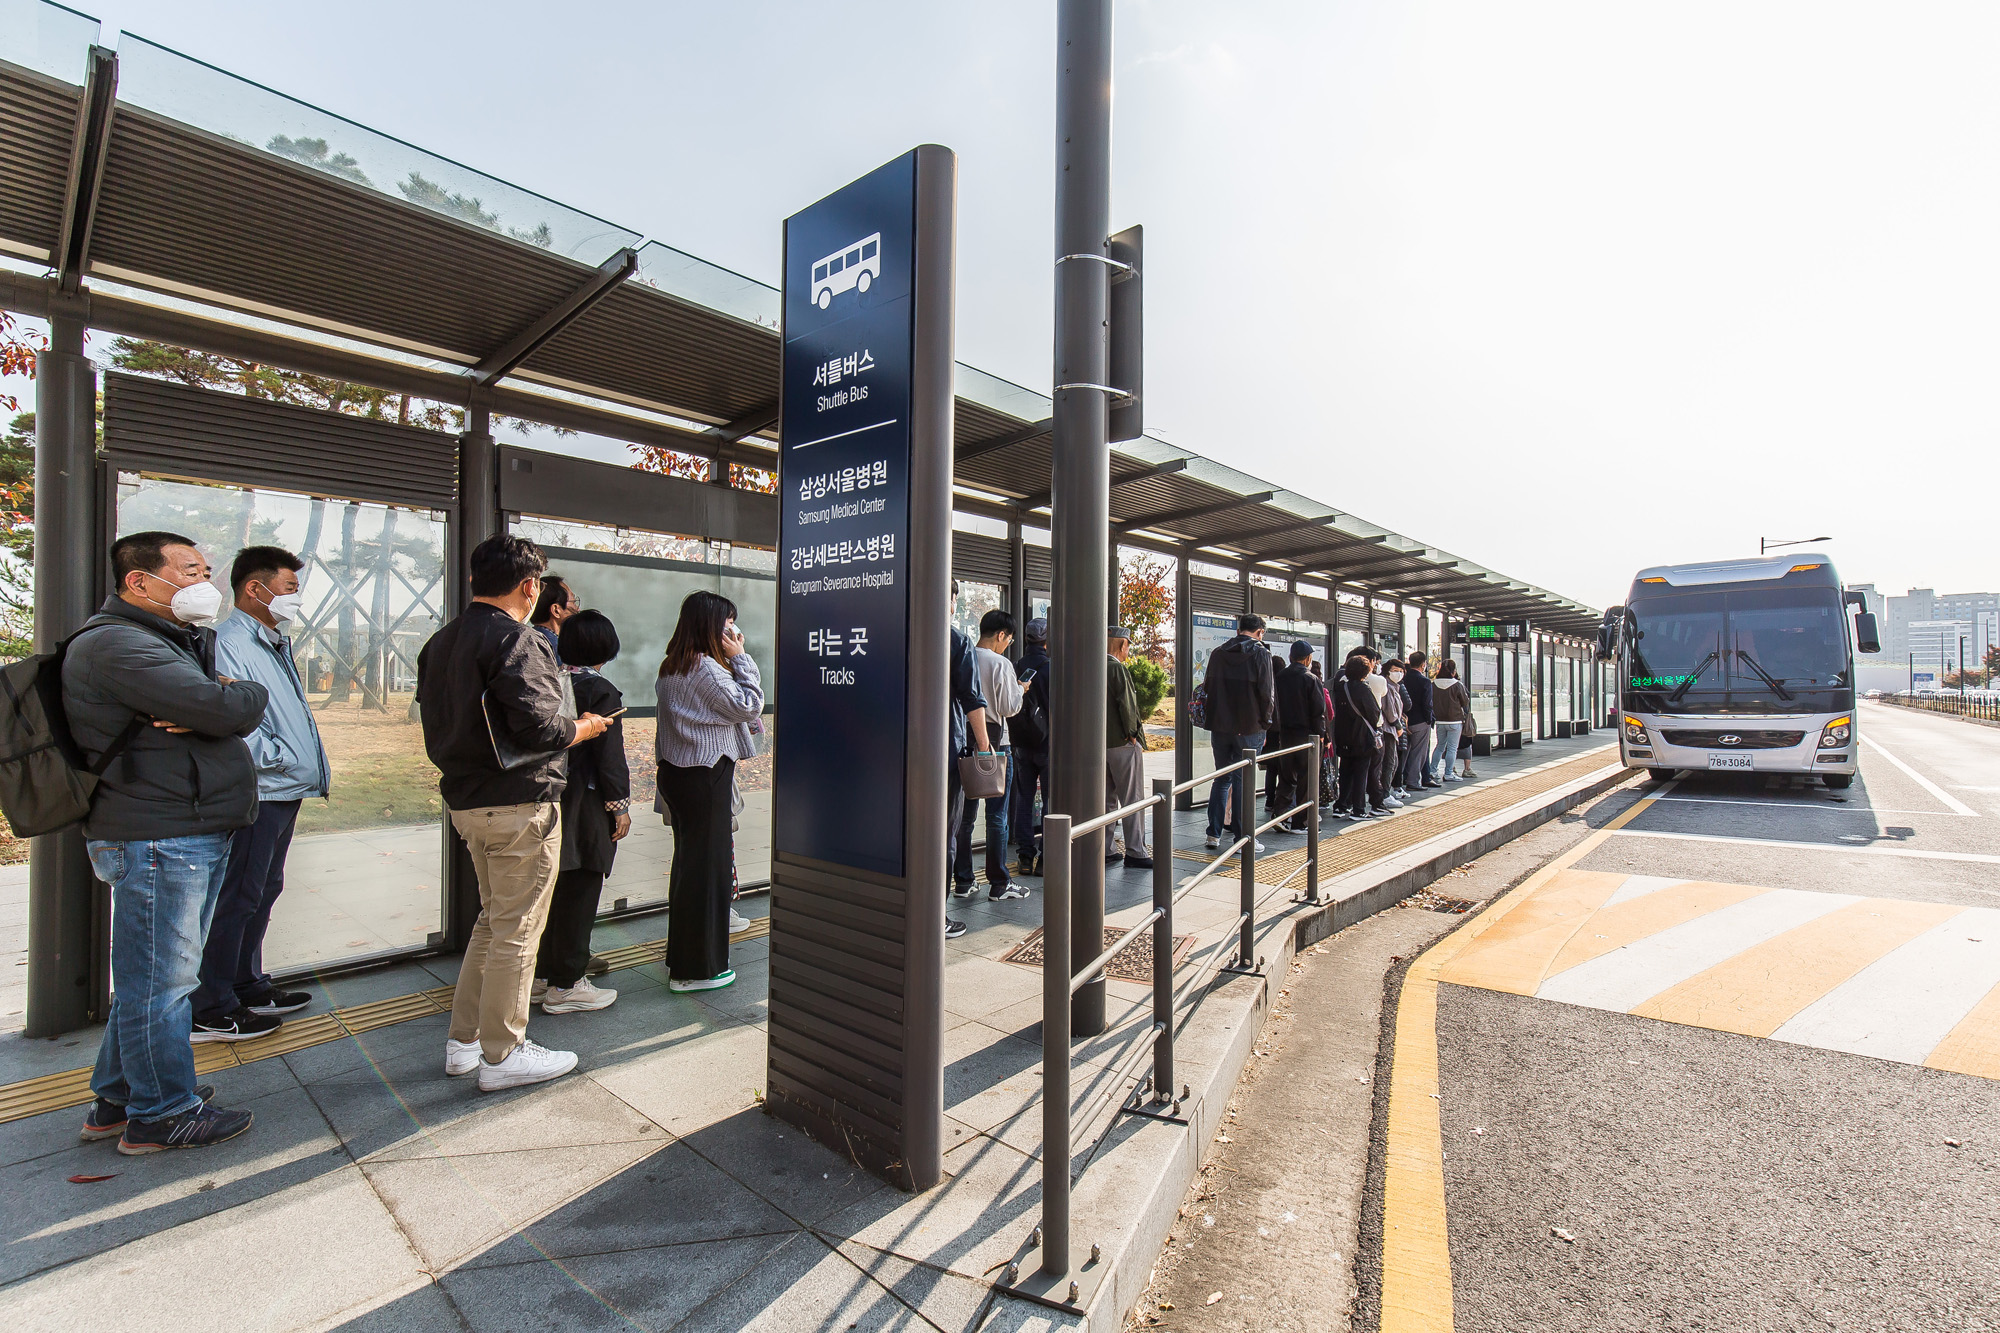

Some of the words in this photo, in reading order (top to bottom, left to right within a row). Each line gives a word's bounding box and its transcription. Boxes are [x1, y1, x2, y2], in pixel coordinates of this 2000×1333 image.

[812, 349, 875, 386] 셔틀버스
[817, 389, 848, 412] Shuttle
[850, 385, 868, 402] Bus
[799, 460, 887, 500] 삼성서울병원
[798, 507, 830, 525] Samsung
[831, 501, 859, 520] Medical
[860, 497, 886, 514] Center
[790, 533, 895, 570] 강남세브란스병원
[790, 577, 822, 596] Gangnam
[823, 574, 861, 591] Severance
[862, 569, 894, 590] Hospital
[808, 628, 843, 656] 타는
[849, 627, 868, 656] 곳
[819, 666, 855, 685] Tracks
[1631, 674, 1698, 687] 삼성서울병원
